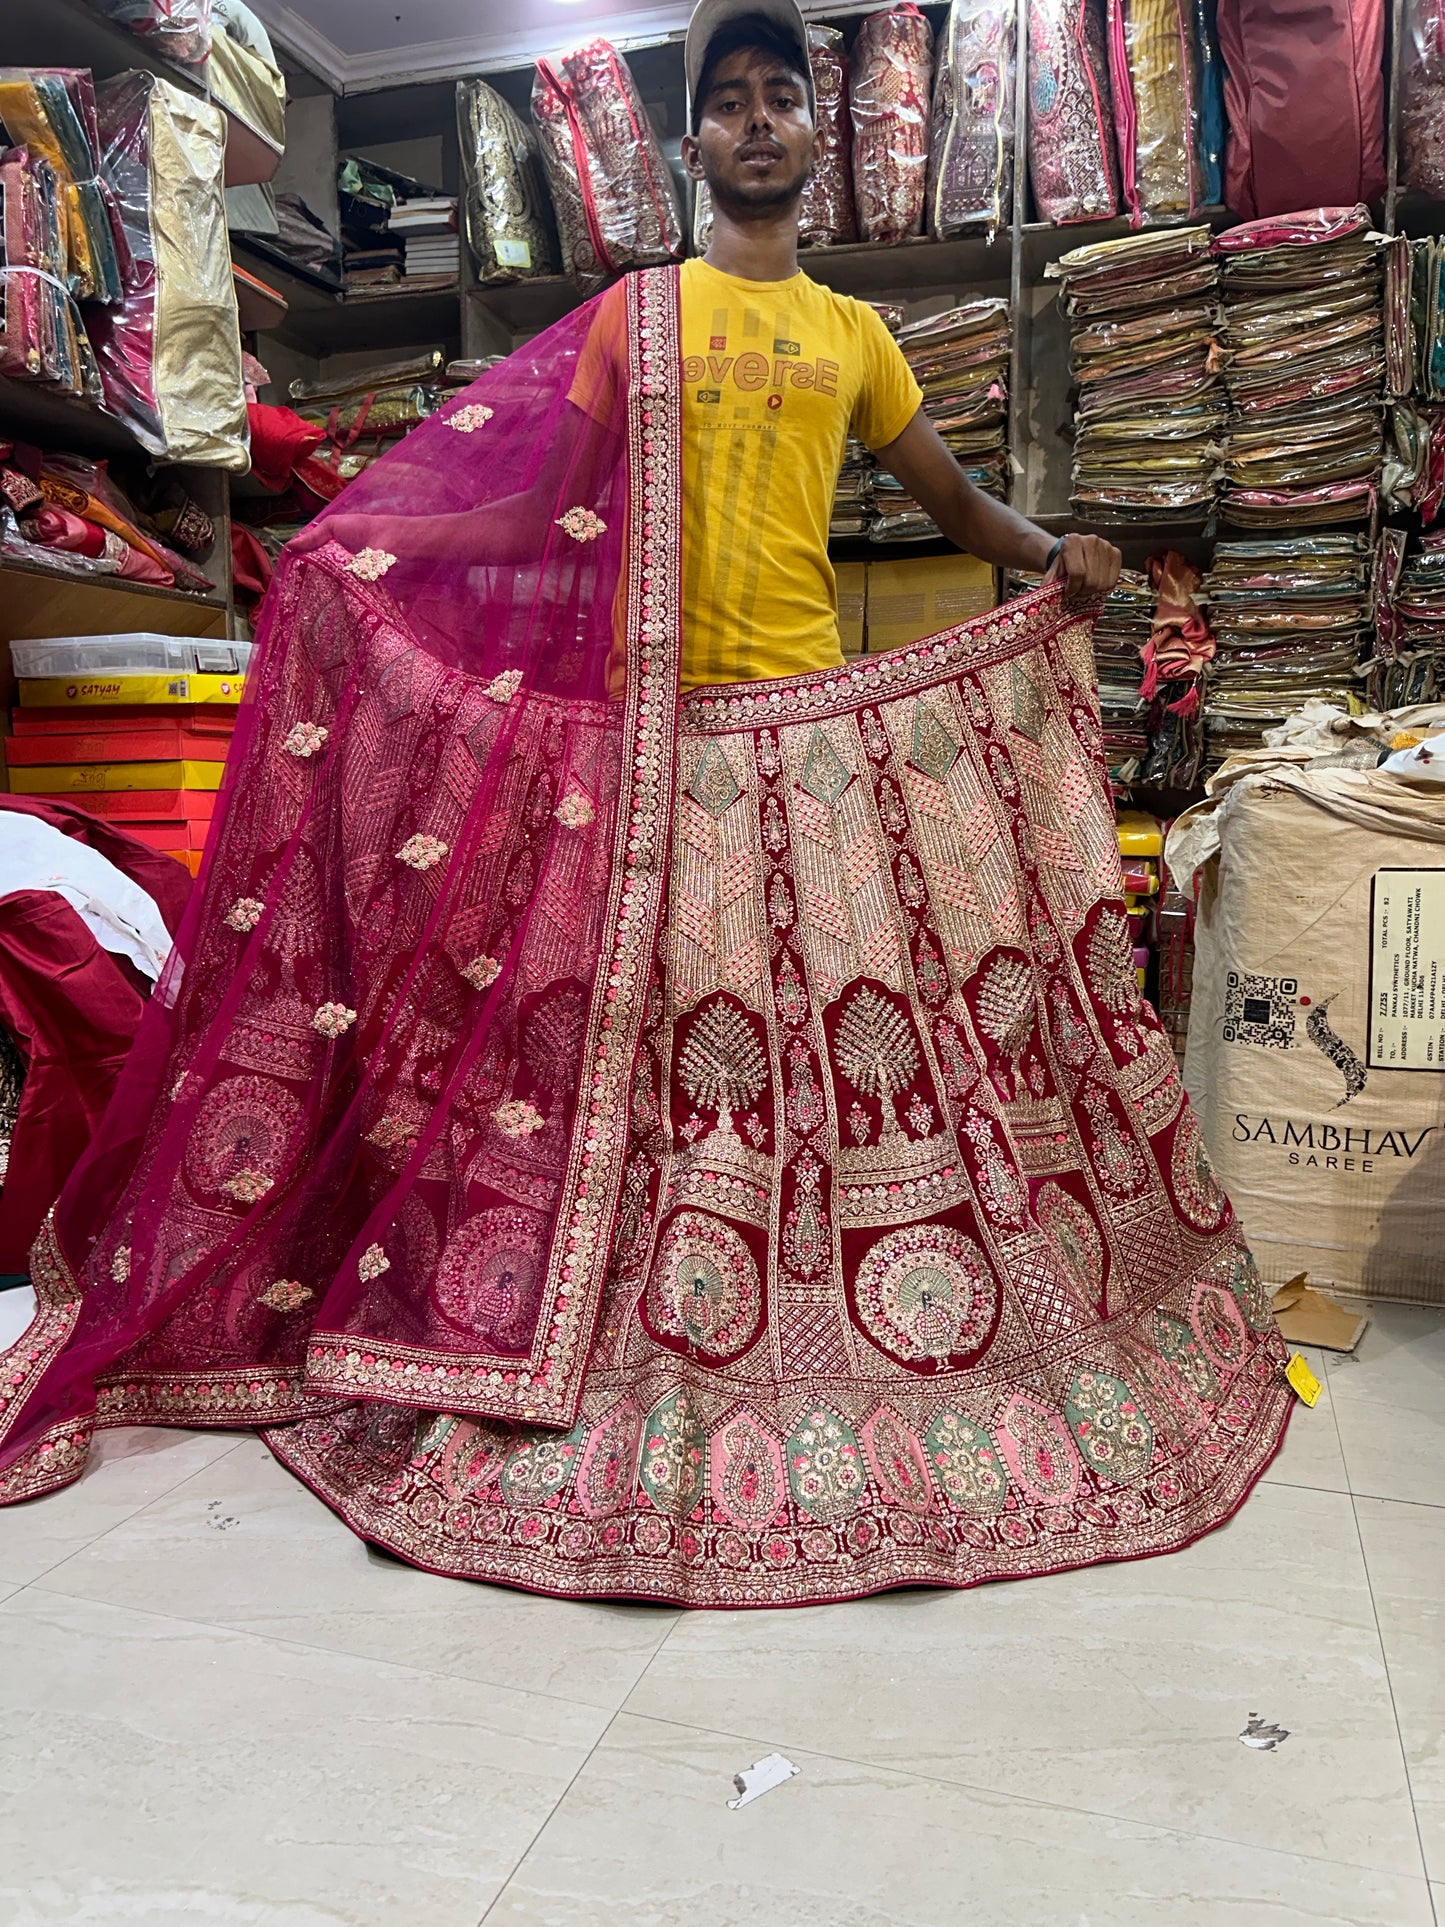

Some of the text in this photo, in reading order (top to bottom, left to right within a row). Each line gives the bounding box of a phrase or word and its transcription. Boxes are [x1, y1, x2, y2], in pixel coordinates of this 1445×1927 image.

[81, 684, 120, 697] SATYAM
[1378, 1034, 1384, 1043] NO
[1232, 1114, 1438, 1158] SAMBHAV
[1288, 1152, 1373, 1173] SAREE
